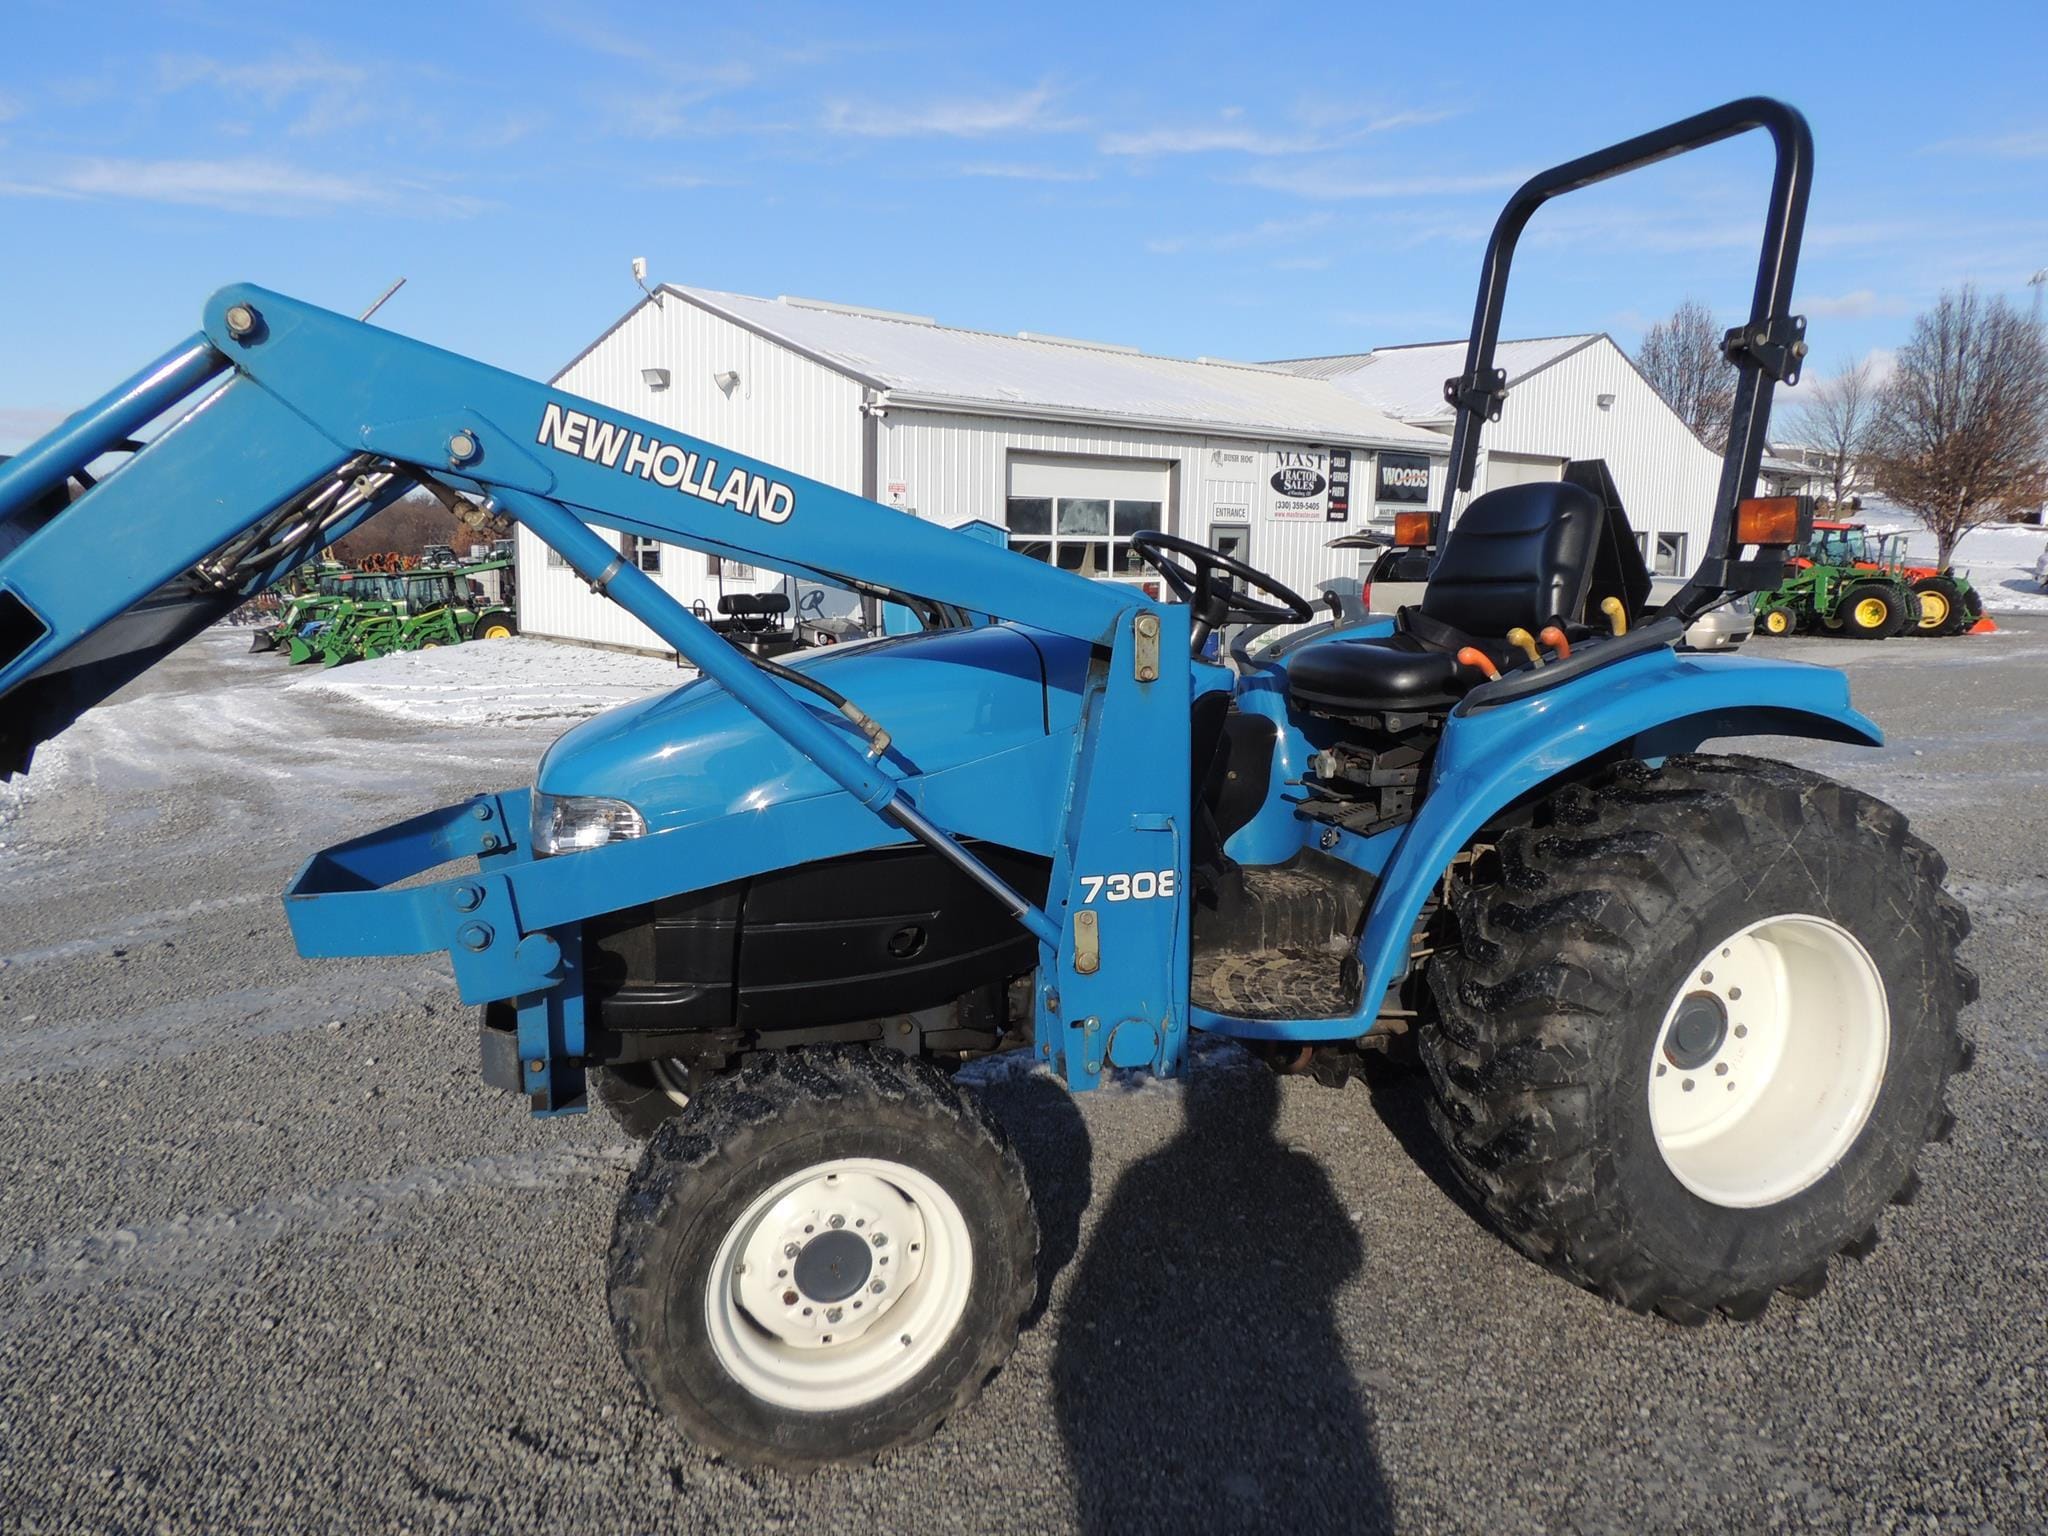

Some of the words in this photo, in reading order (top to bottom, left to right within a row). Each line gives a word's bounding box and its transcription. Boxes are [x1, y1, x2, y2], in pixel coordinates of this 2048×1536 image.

[536, 402, 630, 468] NEW
[622, 432, 796, 525] HOLLAND
[1223, 453, 1239, 463] BUSH
[1276, 450, 1326, 469] MAST
[1279, 467, 1318, 482] TRACTOR
[1382, 466, 1429, 488] WOODS
[1283, 479, 1315, 491] SALES
[1215, 507, 1246, 518] ENTRANCE
[1275, 501, 1291, 511] (330)
[1080, 869, 1182, 905] 7308
